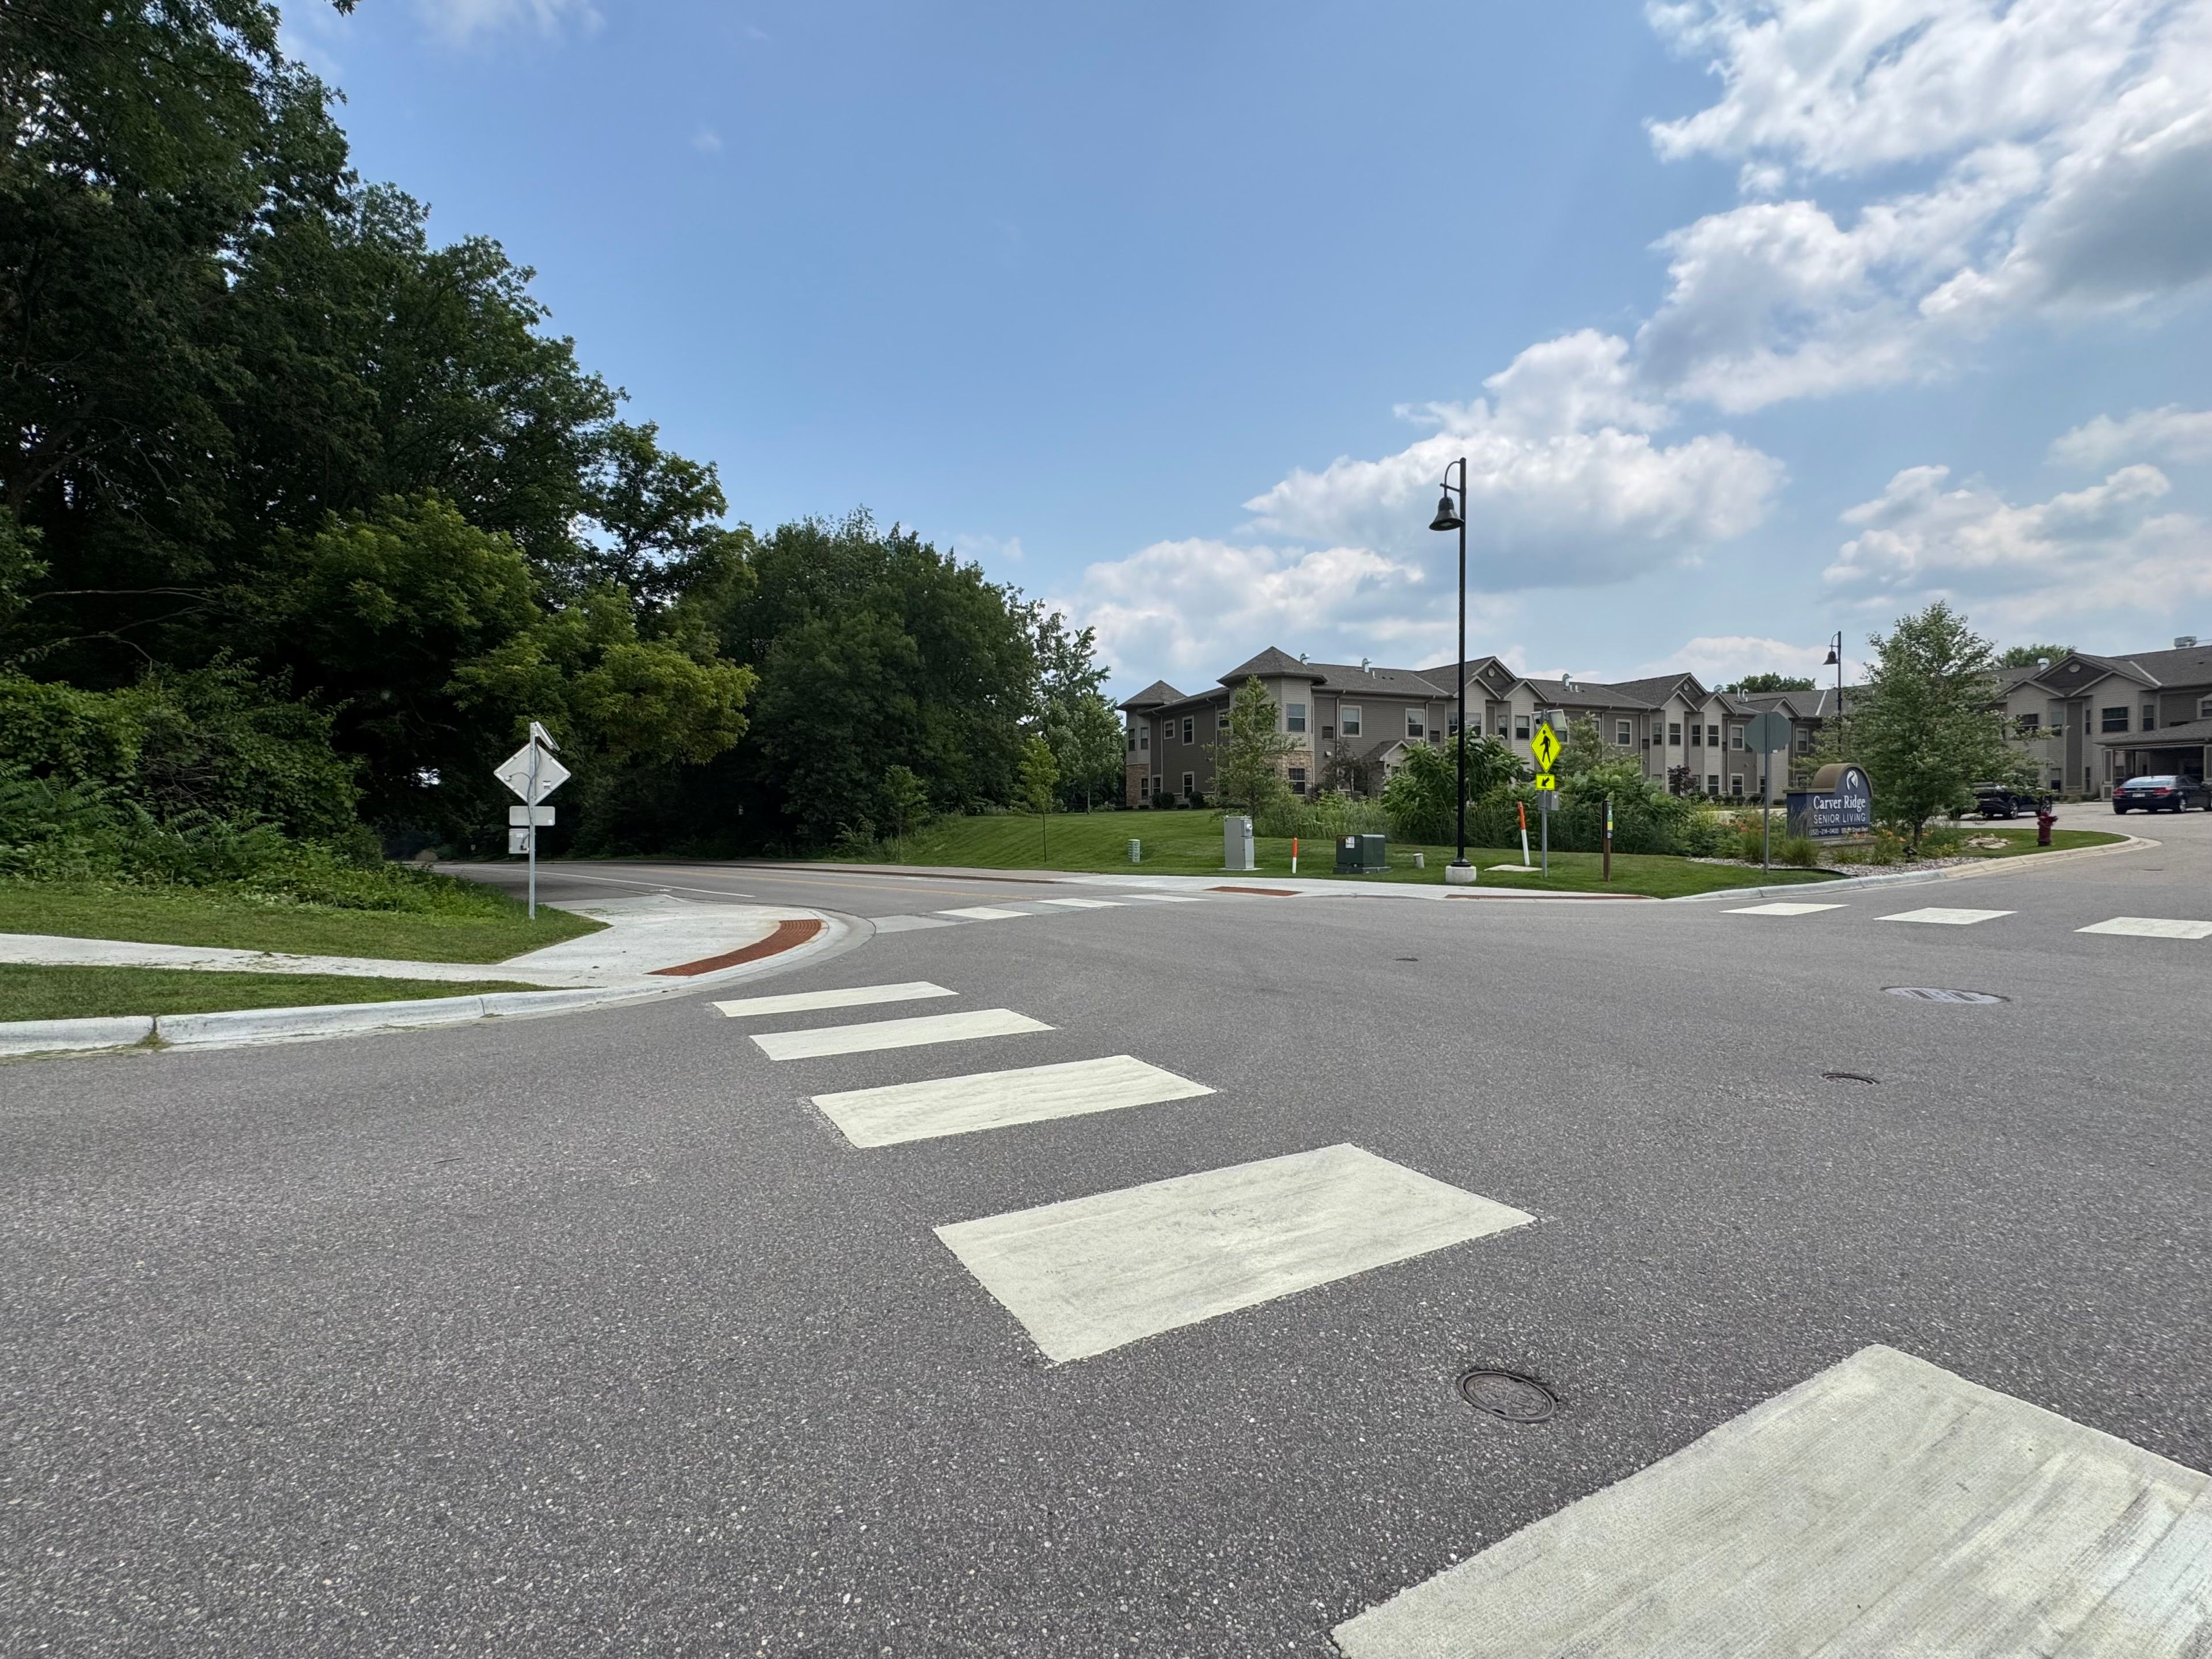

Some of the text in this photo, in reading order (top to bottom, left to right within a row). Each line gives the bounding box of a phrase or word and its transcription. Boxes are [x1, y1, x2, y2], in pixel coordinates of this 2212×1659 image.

[1813, 794, 1866, 812] Carver Ridge
[1813, 812, 1866, 824] SENIOR LIVING
